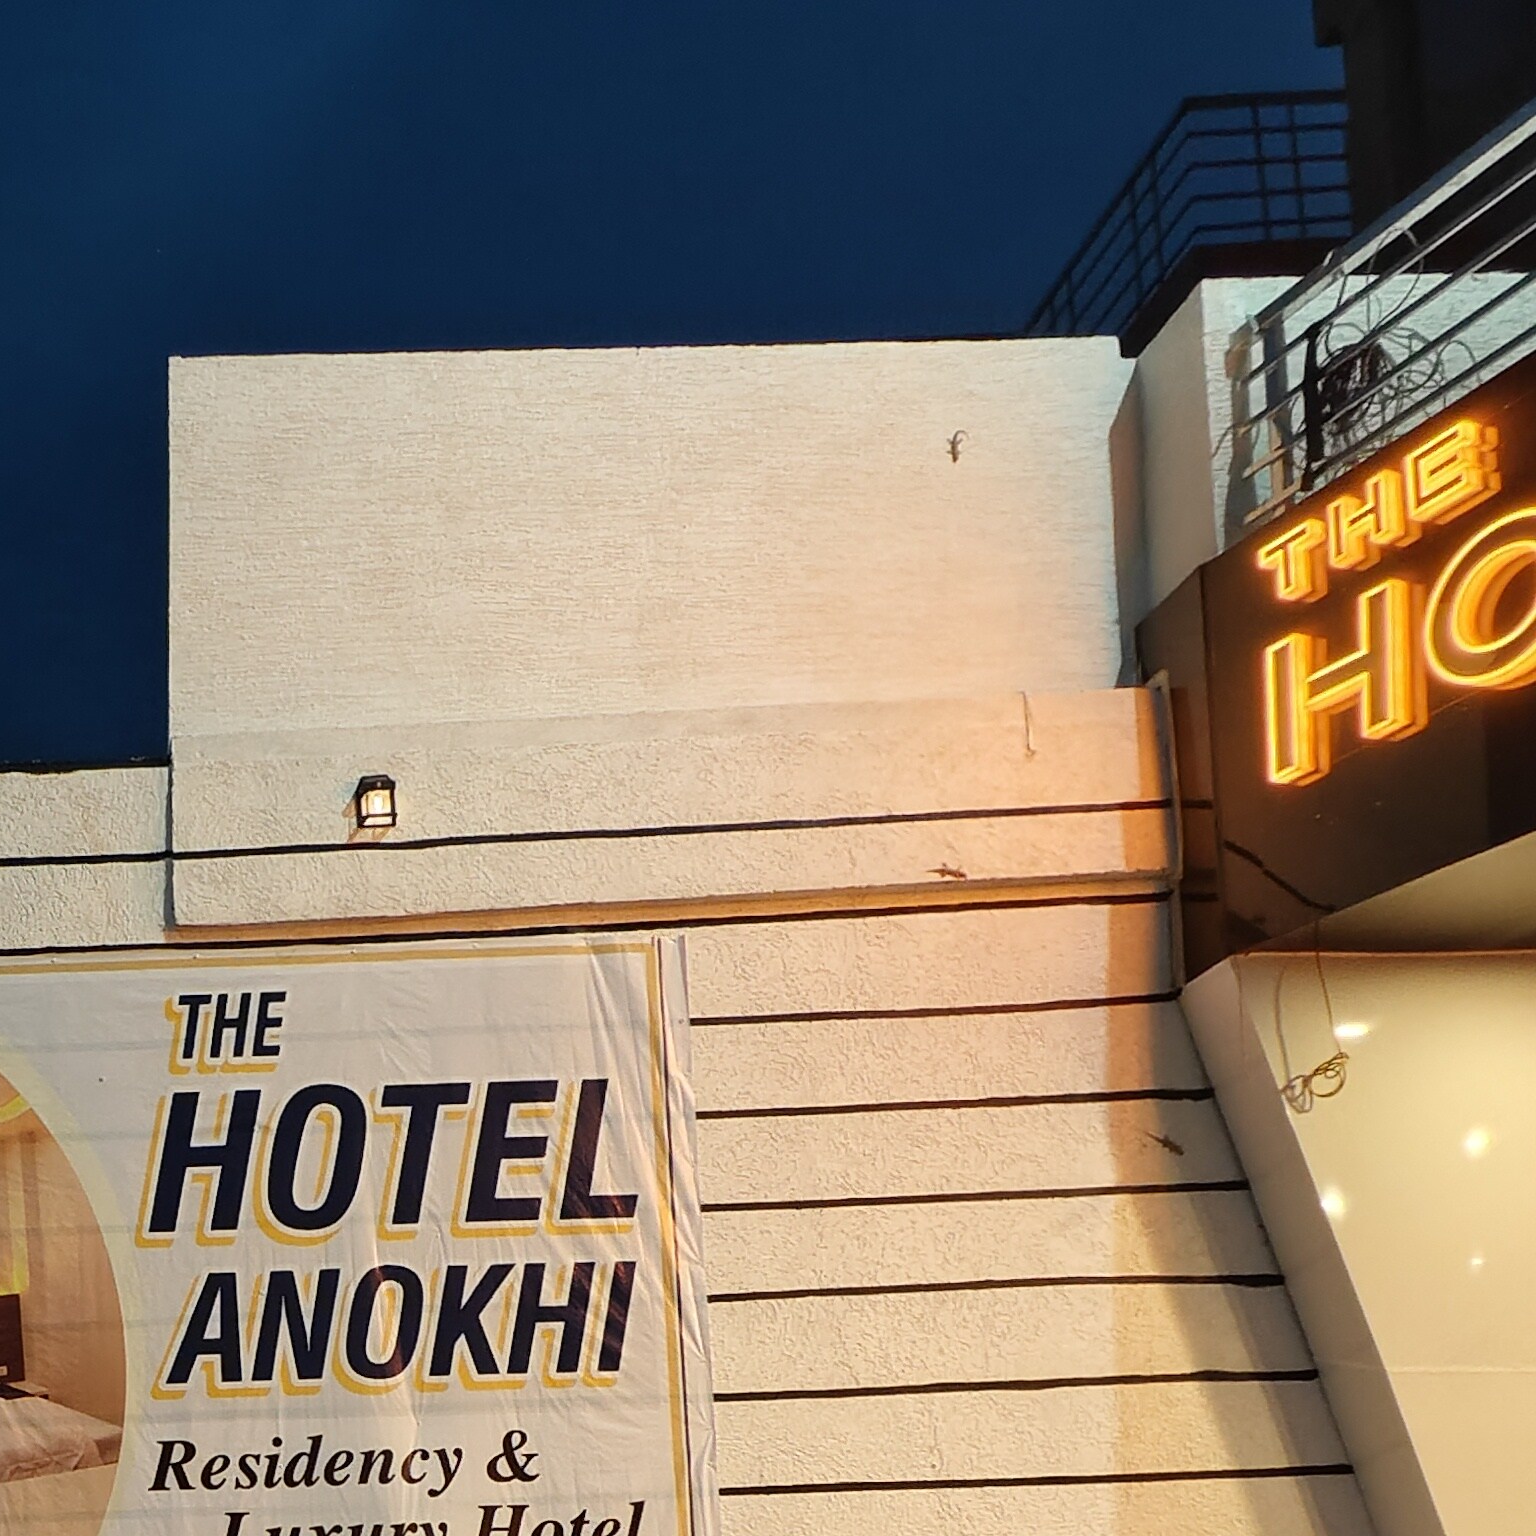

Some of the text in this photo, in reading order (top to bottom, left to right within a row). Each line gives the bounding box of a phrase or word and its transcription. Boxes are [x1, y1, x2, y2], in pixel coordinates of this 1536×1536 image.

[1257, 420, 1501, 602] THE
[174, 990, 288, 1062] THE
[145, 1078, 640, 1236] HOTEL
[163, 1260, 637, 1388] ANOKHI
[148, 1429, 540, 1498] Residency &
